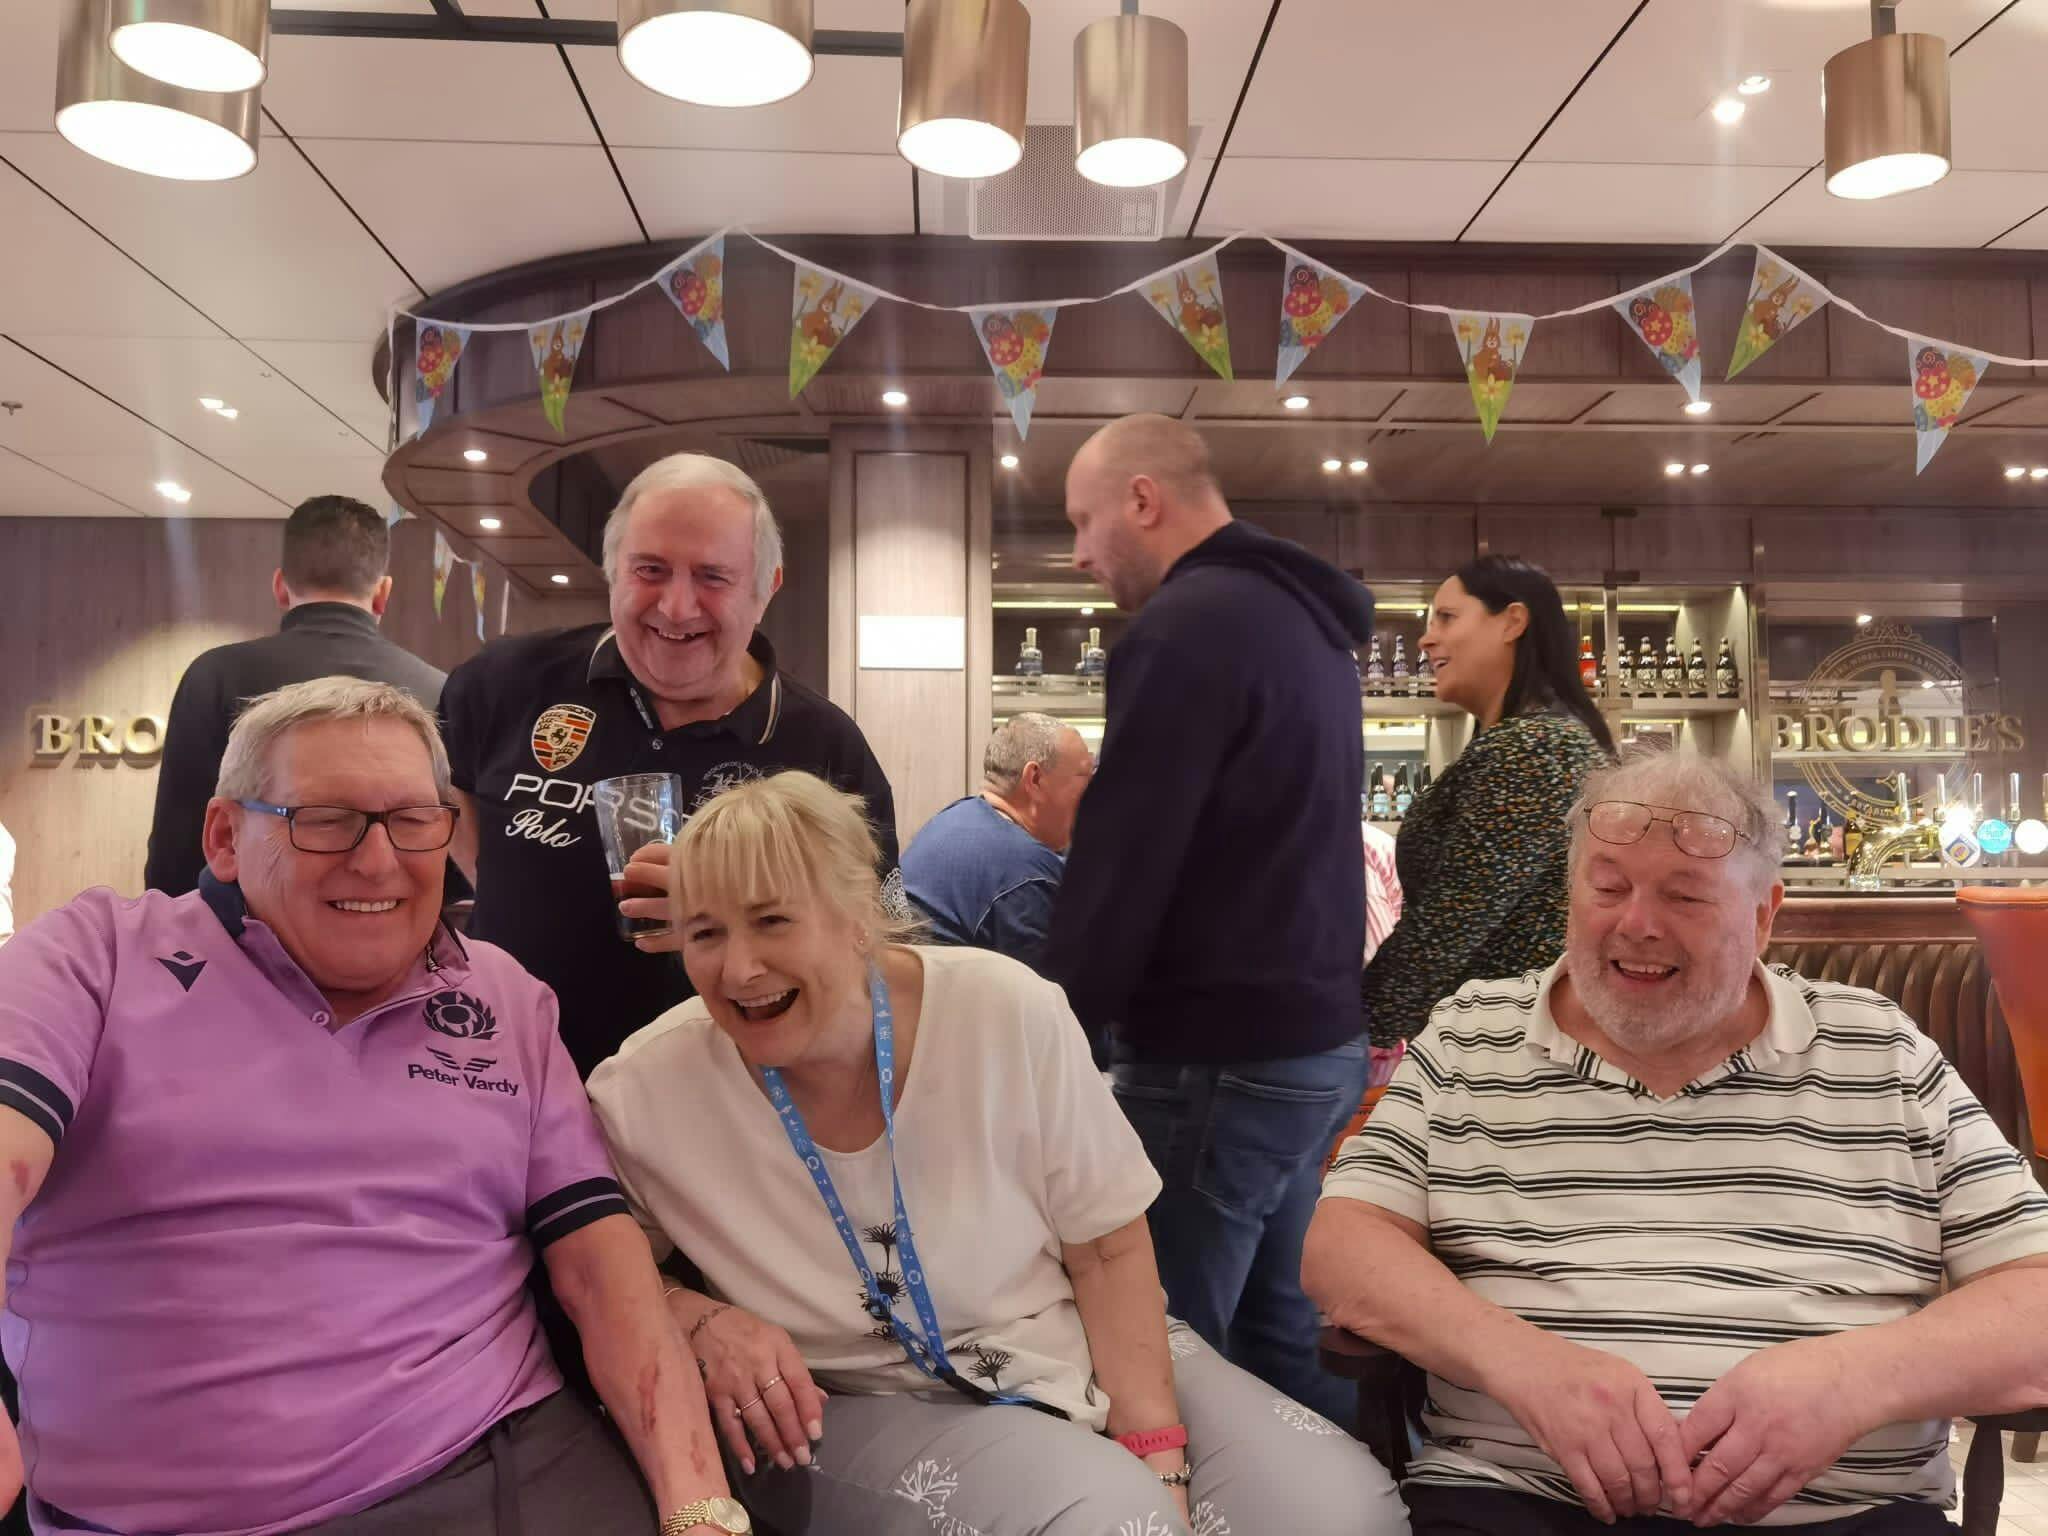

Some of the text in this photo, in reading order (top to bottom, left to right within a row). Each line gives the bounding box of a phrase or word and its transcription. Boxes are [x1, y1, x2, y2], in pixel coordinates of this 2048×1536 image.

[36, 714, 165, 754] BRO
[1768, 713, 2024, 752] BRODIE'S
[504, 774, 691, 843] PORSC
[505, 808, 581, 847] Polo
[408, 1064, 519, 1096] Peter Vardy
